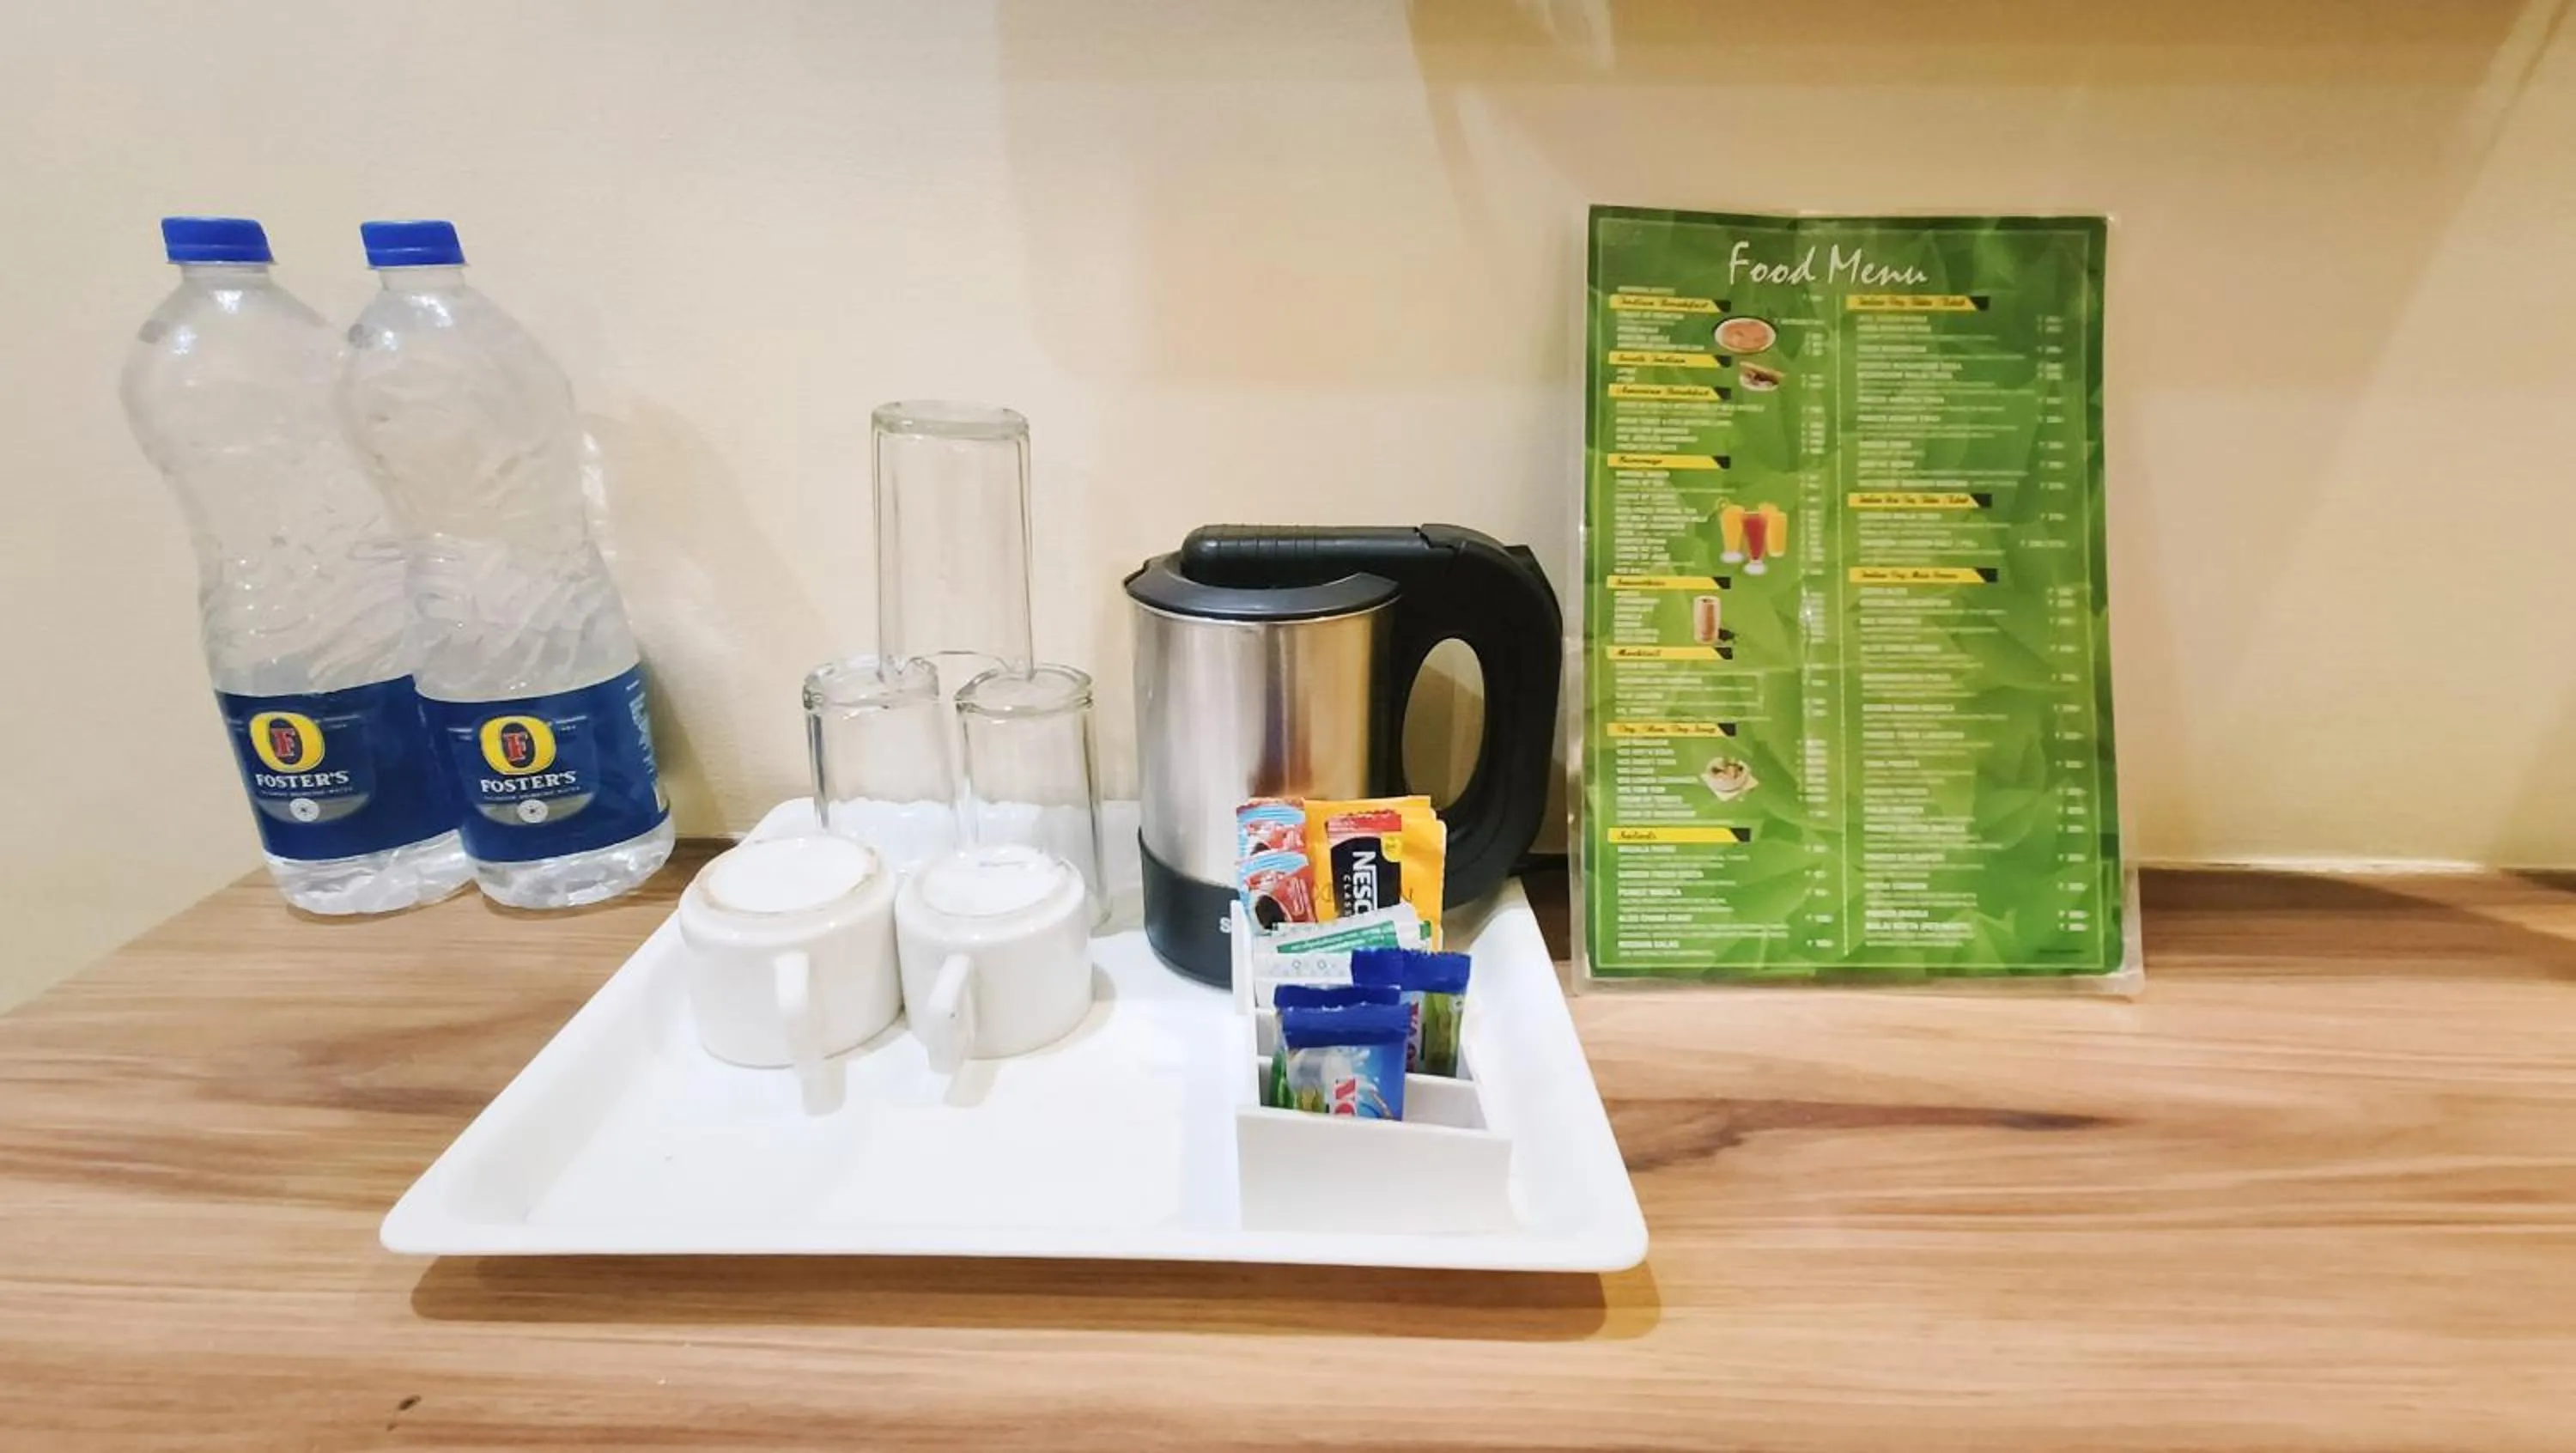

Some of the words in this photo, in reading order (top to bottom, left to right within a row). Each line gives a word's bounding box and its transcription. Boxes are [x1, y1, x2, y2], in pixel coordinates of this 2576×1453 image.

[1728, 240, 1817, 285] Food
[1828, 244, 1928, 285] Menu
[254, 769, 351, 789] FOSTER'S
[479, 769, 578, 793] FOSTER'S
[1342, 874, 1352, 917] CLASS
[1352, 850, 1377, 915] NESC
